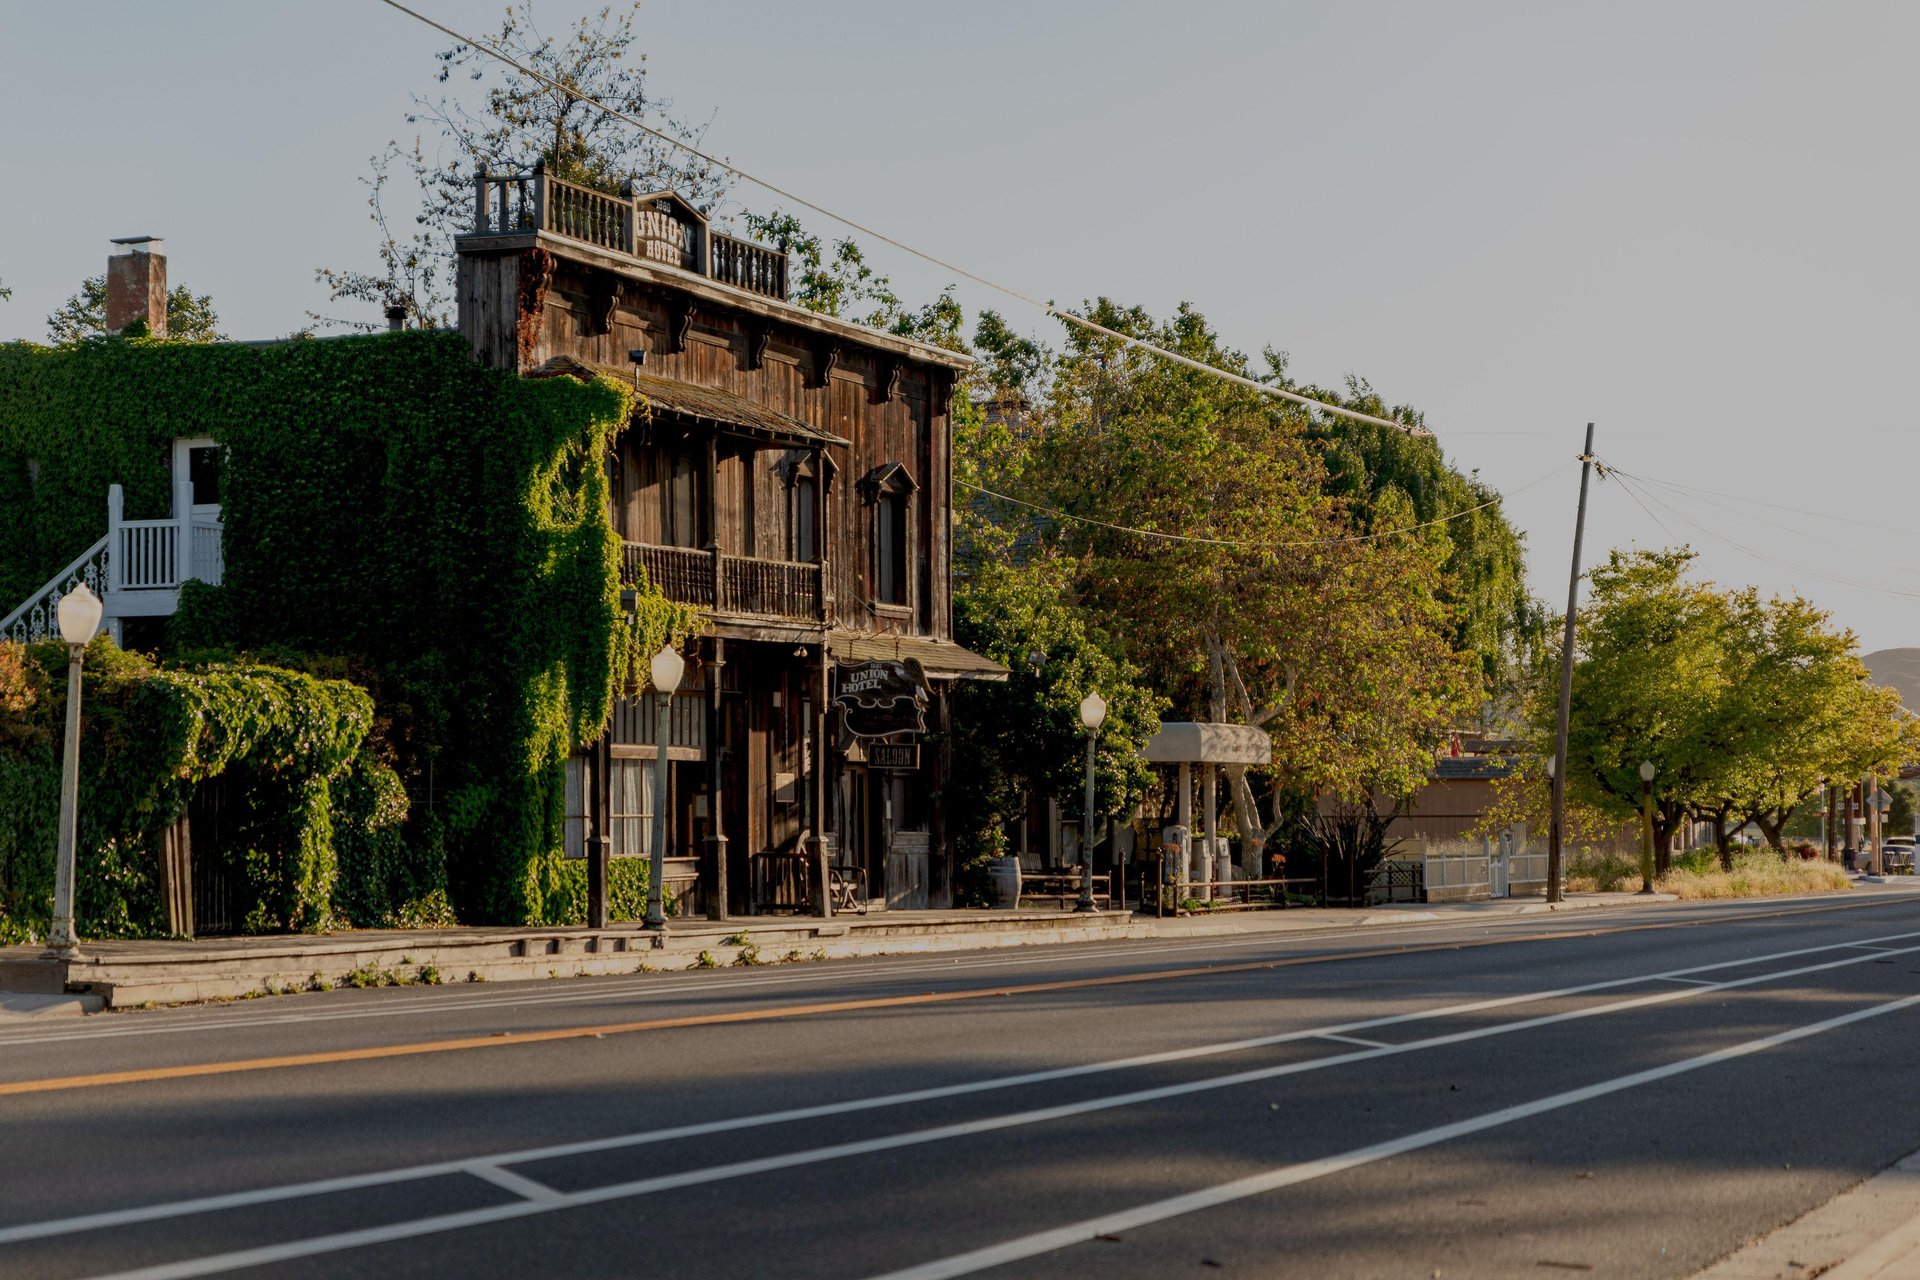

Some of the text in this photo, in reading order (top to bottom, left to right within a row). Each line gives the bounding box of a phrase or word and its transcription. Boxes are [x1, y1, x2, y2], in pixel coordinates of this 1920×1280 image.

[636, 211, 692, 253] UNION
[646, 240, 681, 266] HOTEL
[850, 669, 889, 683] UNION
[841, 679, 882, 693] HOTEL
[874, 748, 911, 765] SALOON
